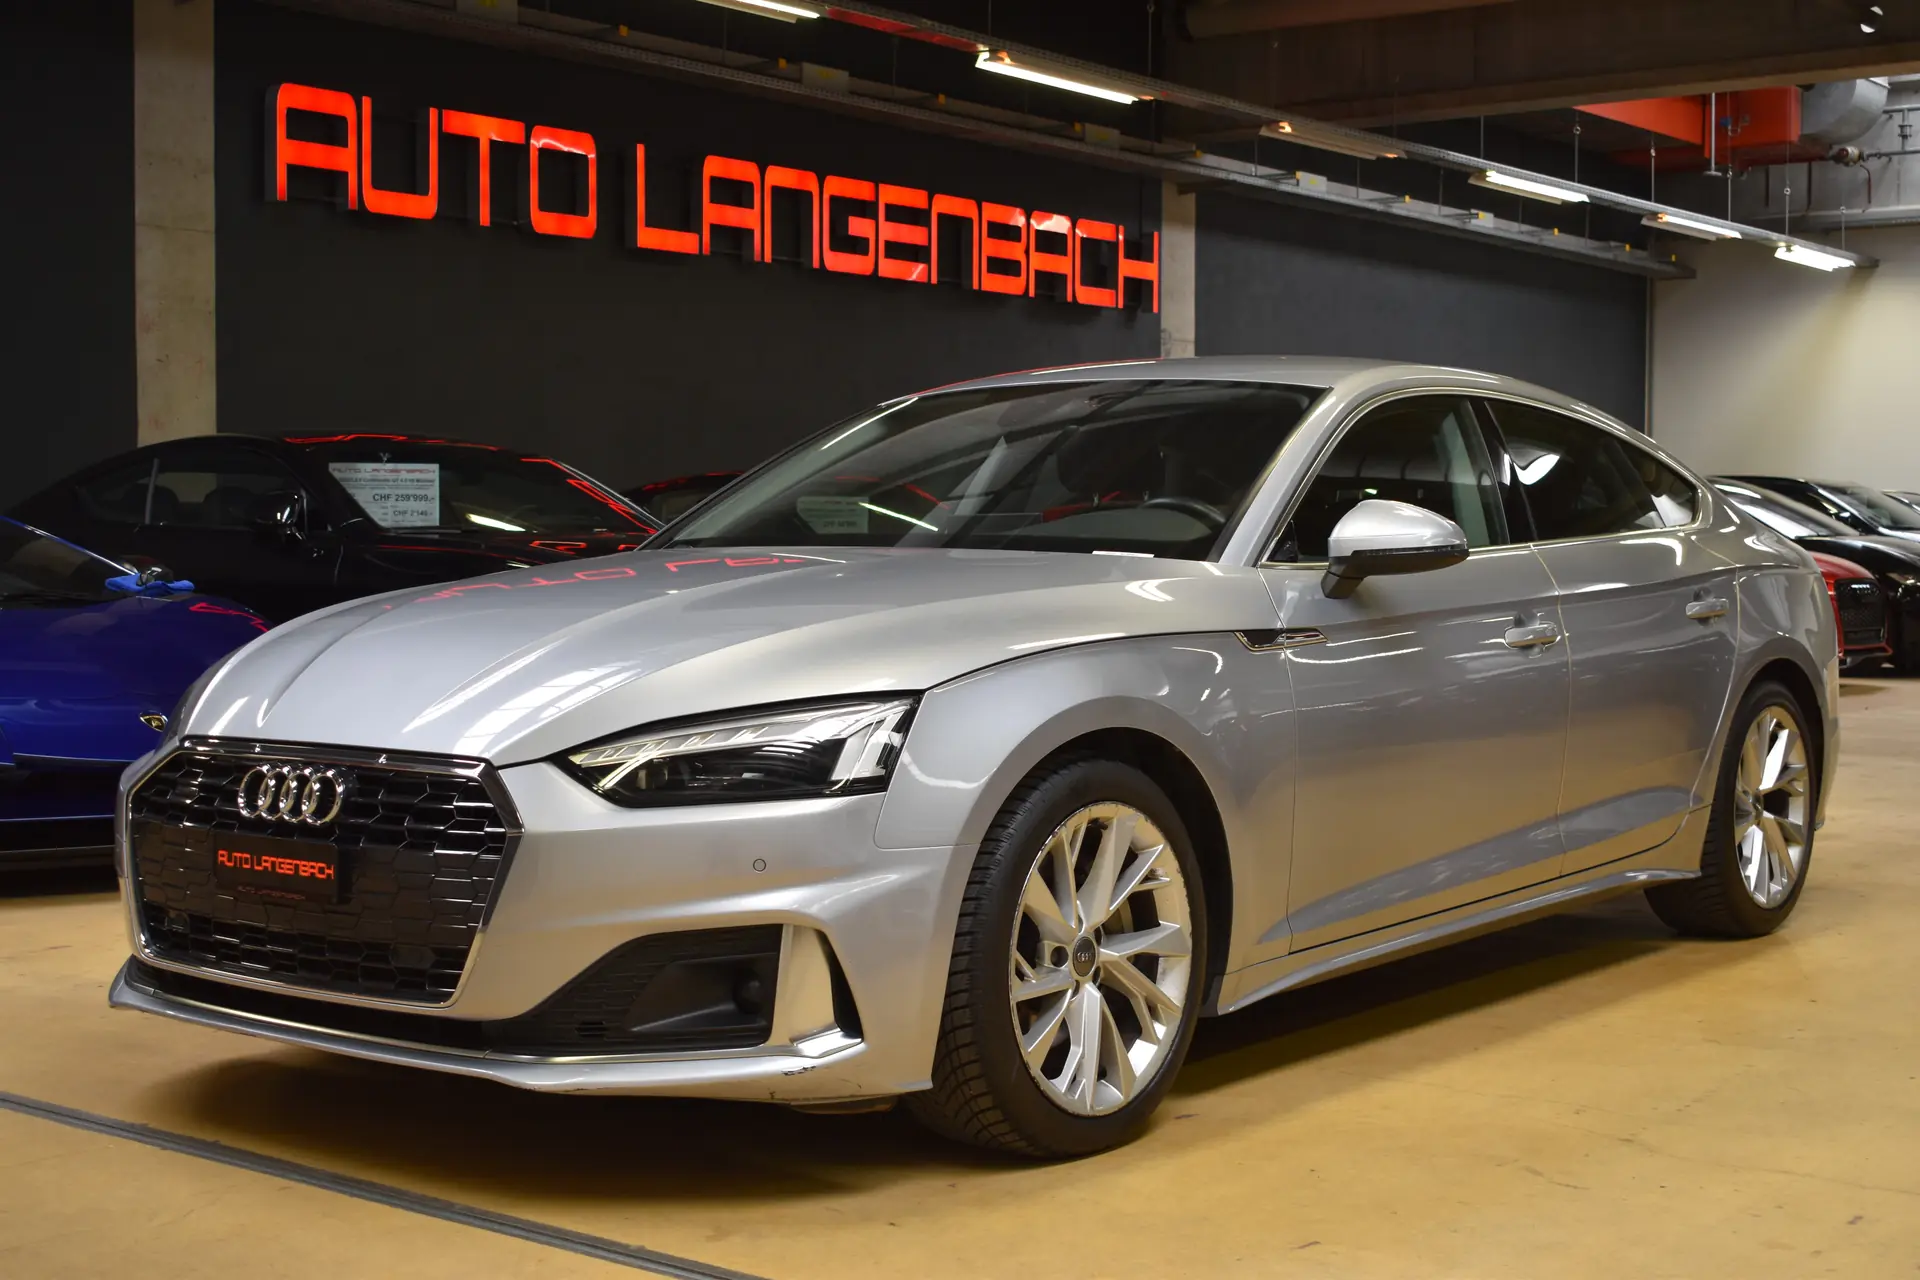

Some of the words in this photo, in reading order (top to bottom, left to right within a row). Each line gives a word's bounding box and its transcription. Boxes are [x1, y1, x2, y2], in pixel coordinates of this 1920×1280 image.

[276, 82, 597, 239] AUTO
[635, 143, 1160, 313] LANGENBACH
[372, 493, 391, 502] CHF
[218, 850, 251, 868] AUTO
[254, 855, 334, 879] LANGENBACH
